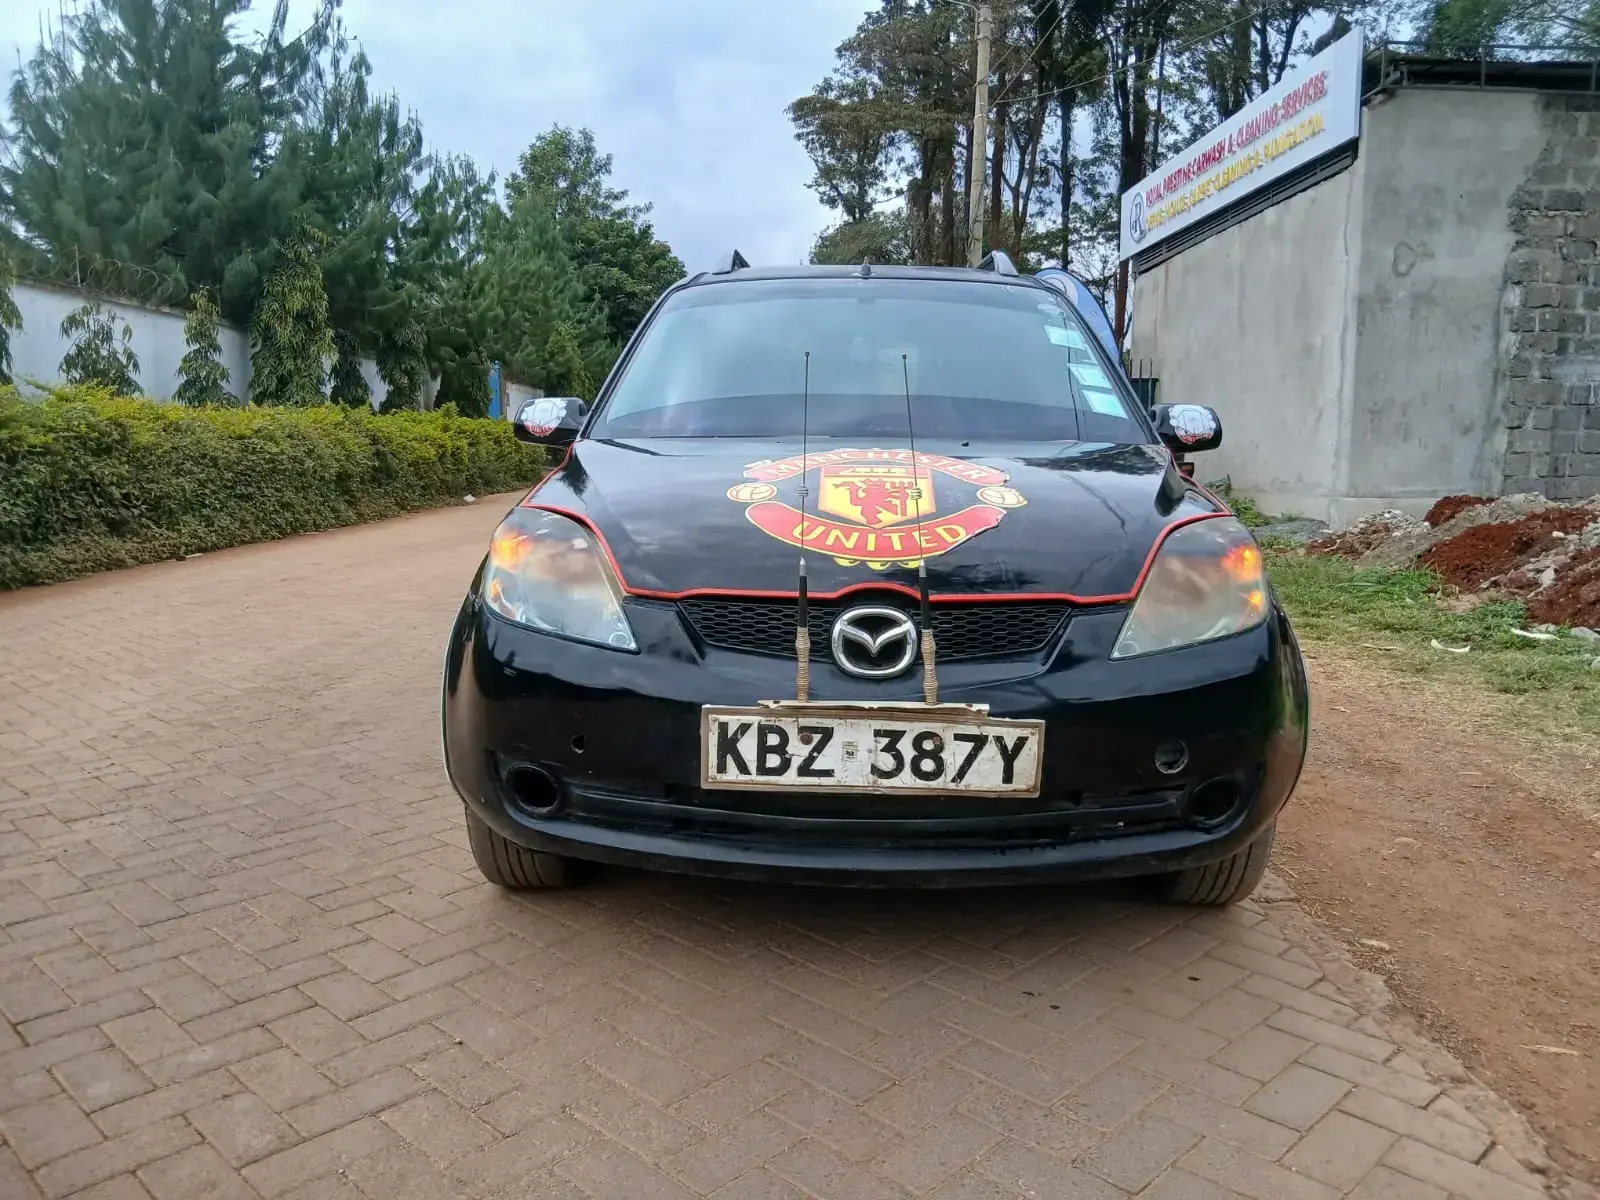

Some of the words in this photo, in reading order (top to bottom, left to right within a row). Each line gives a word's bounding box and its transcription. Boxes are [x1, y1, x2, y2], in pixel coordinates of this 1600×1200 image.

[1236, 102, 1281, 148] CLEANING
[1281, 70, 1326, 119] SERVICES
[767, 450, 989, 480] MANCHESTER
[792, 520, 967, 552] UNITED
[716, 721, 835, 778] KBZ
[870, 729, 1030, 785] 387Y
